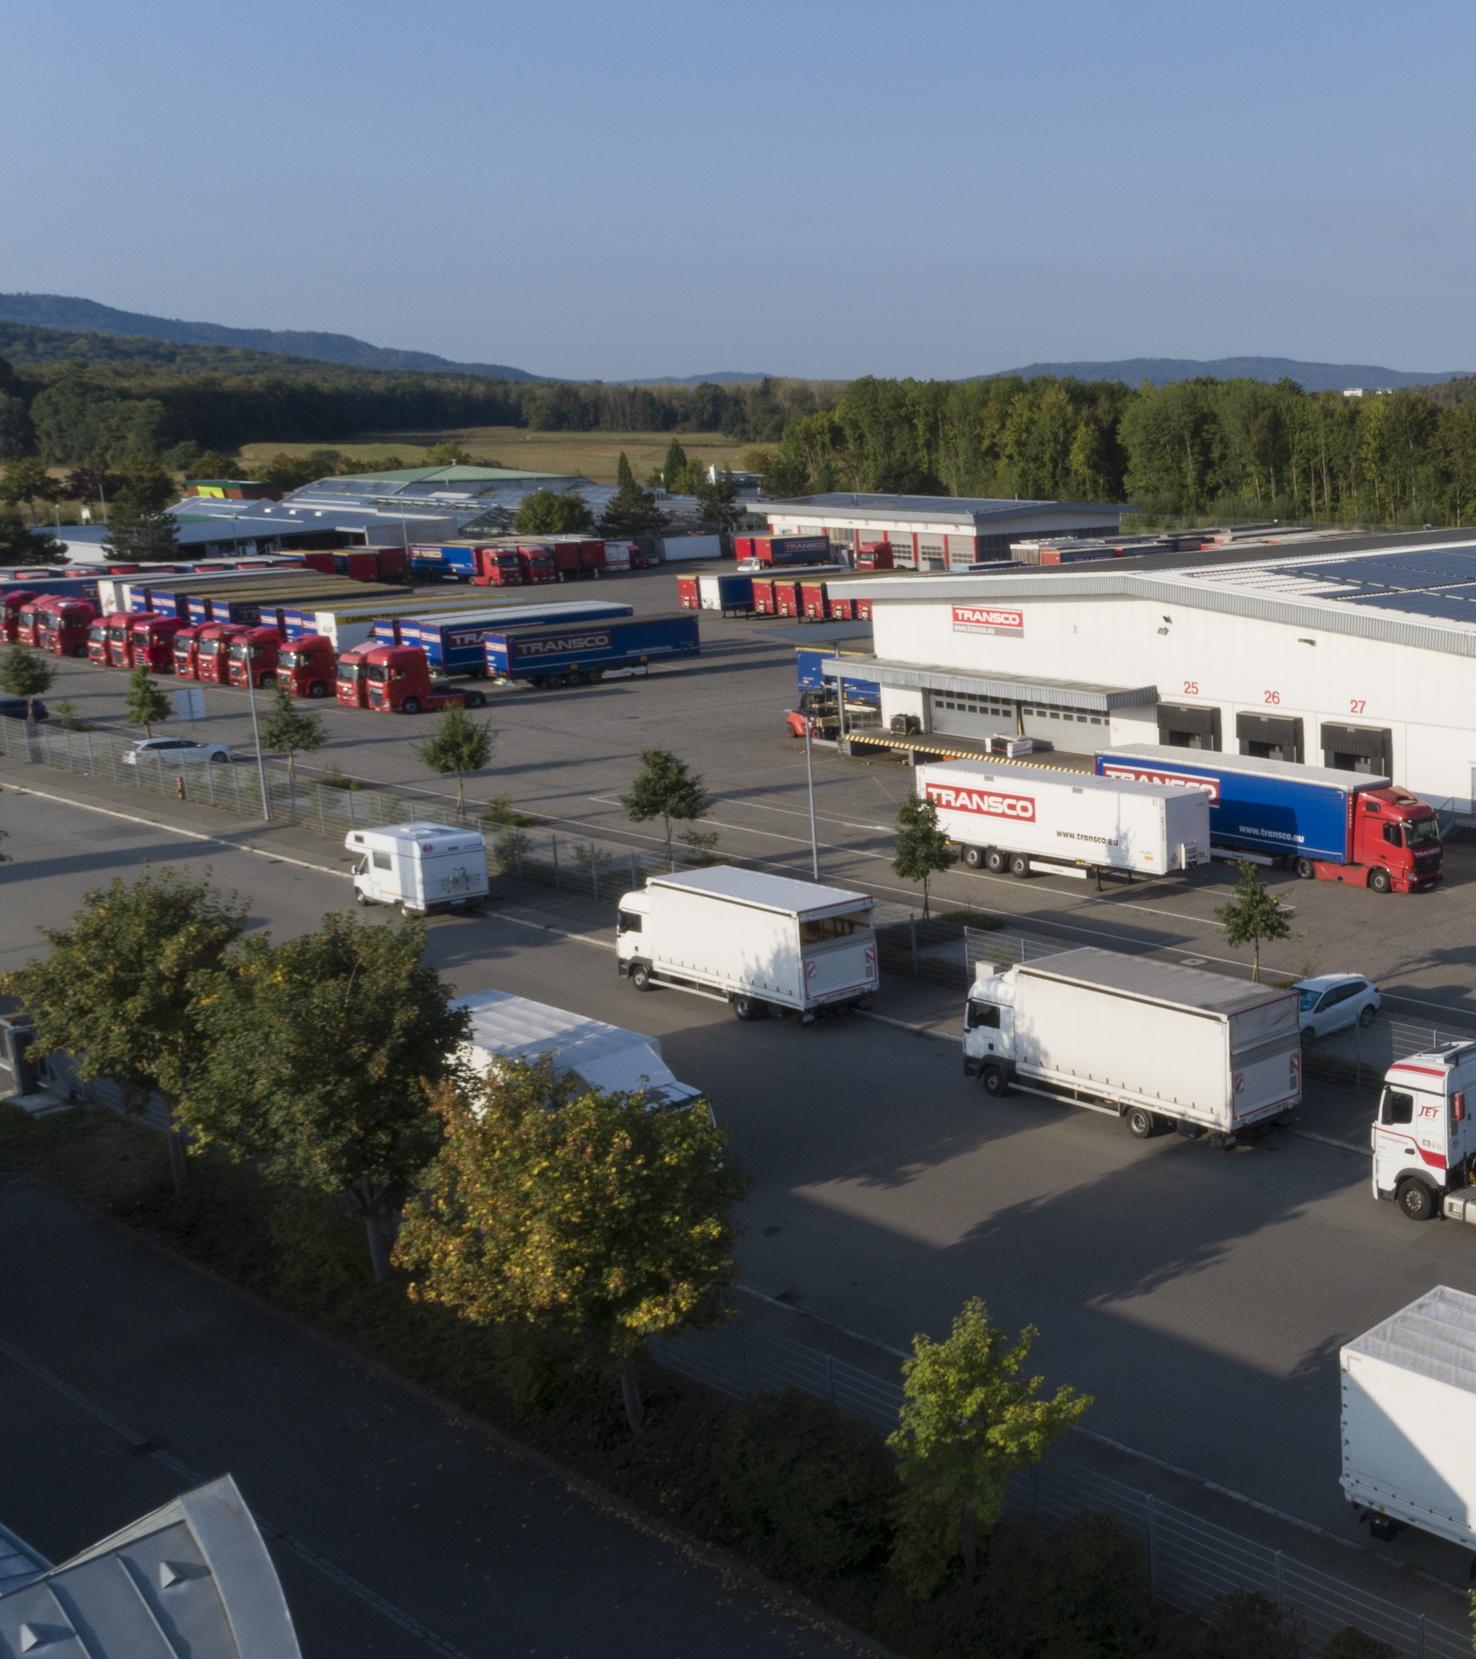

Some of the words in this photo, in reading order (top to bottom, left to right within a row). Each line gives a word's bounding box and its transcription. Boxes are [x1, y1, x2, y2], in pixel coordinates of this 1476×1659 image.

[955, 609, 1020, 625] TRANSCO
[954, 624, 995, 634] www.transco.eu
[518, 635, 609, 655] TRANSCO
[1183, 681, 1199, 694] 25
[1264, 690, 1280, 704] 26
[1350, 700, 1366, 714] 27
[927, 787, 1034, 818] TRANSCO
[1056, 830, 1119, 846] www.transco.eu
[1239, 825, 1304, 843] www.transco.eu
[1417, 1105, 1442, 1118] JET
